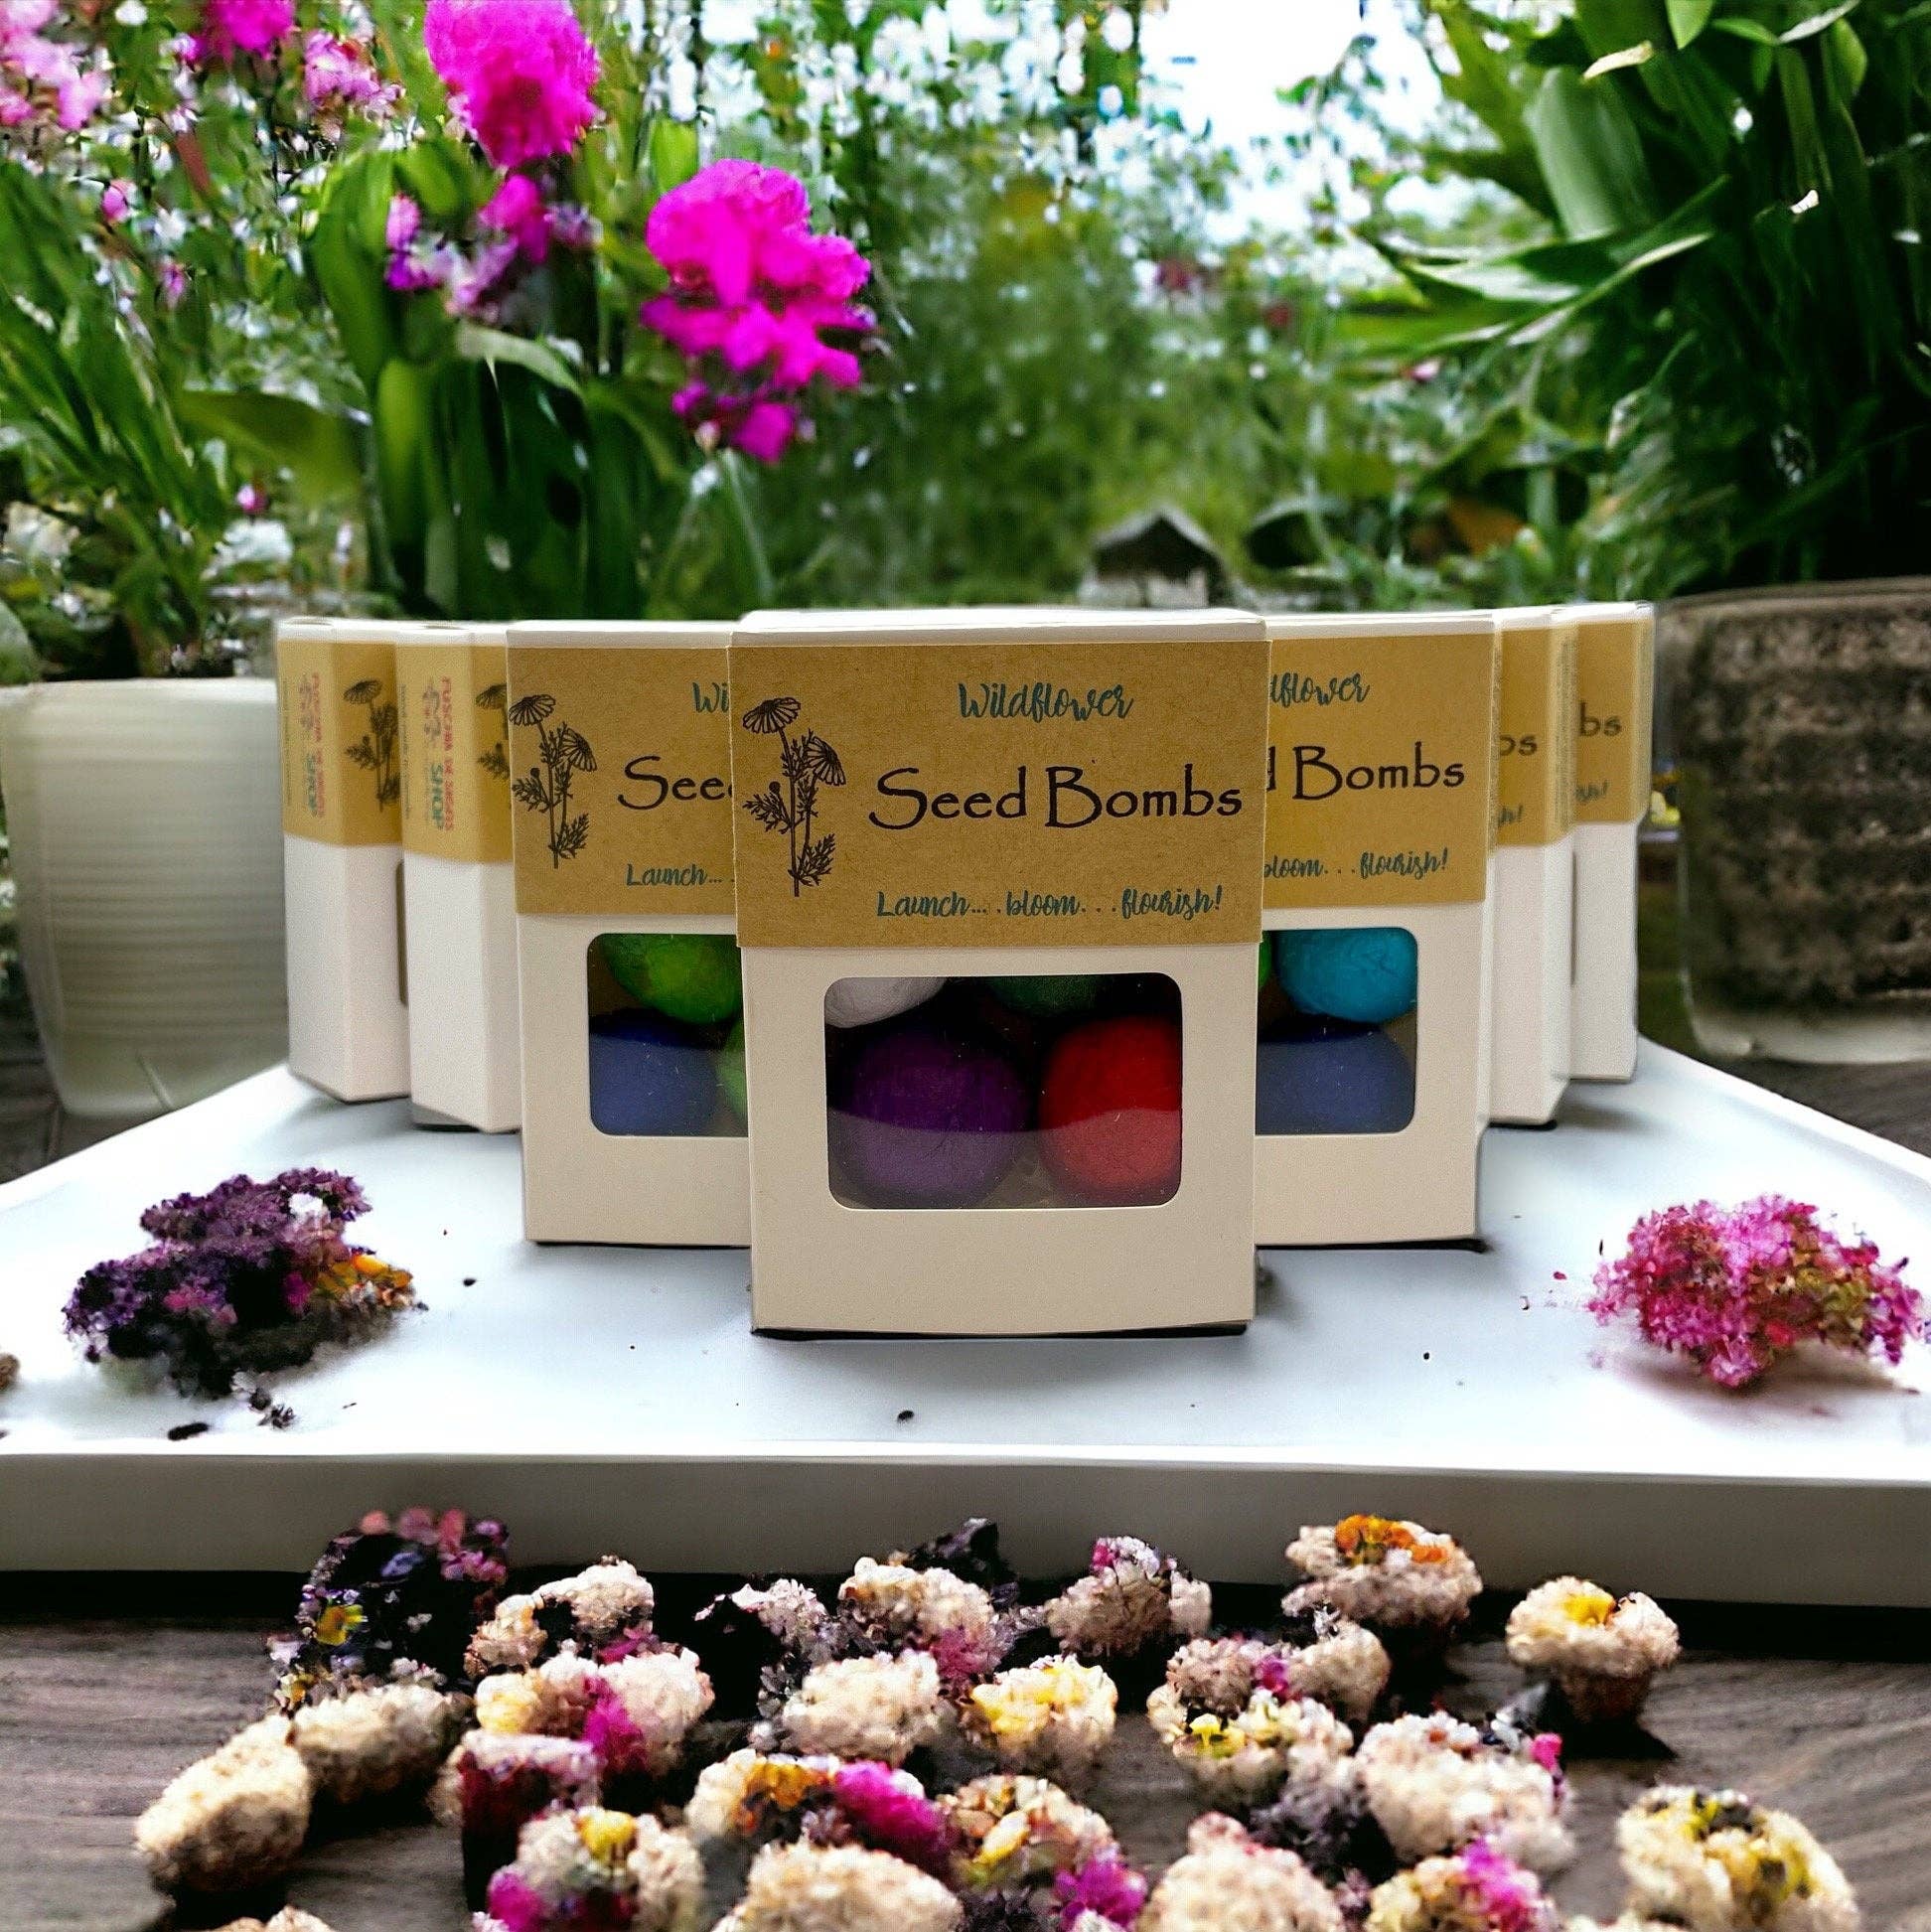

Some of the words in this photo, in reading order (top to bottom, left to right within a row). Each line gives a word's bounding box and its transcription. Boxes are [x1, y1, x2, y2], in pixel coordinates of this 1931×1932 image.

[958, 681, 1134, 722] Wildflower
[618, 755, 732, 810] See
[1292, 741, 1465, 801] Bombs
[868, 765, 1027, 829] Seed
[1045, 763, 1243, 828] Bombs
[1360, 847, 1448, 879] flourish!
[1121, 885, 1223, 921] flourish!
